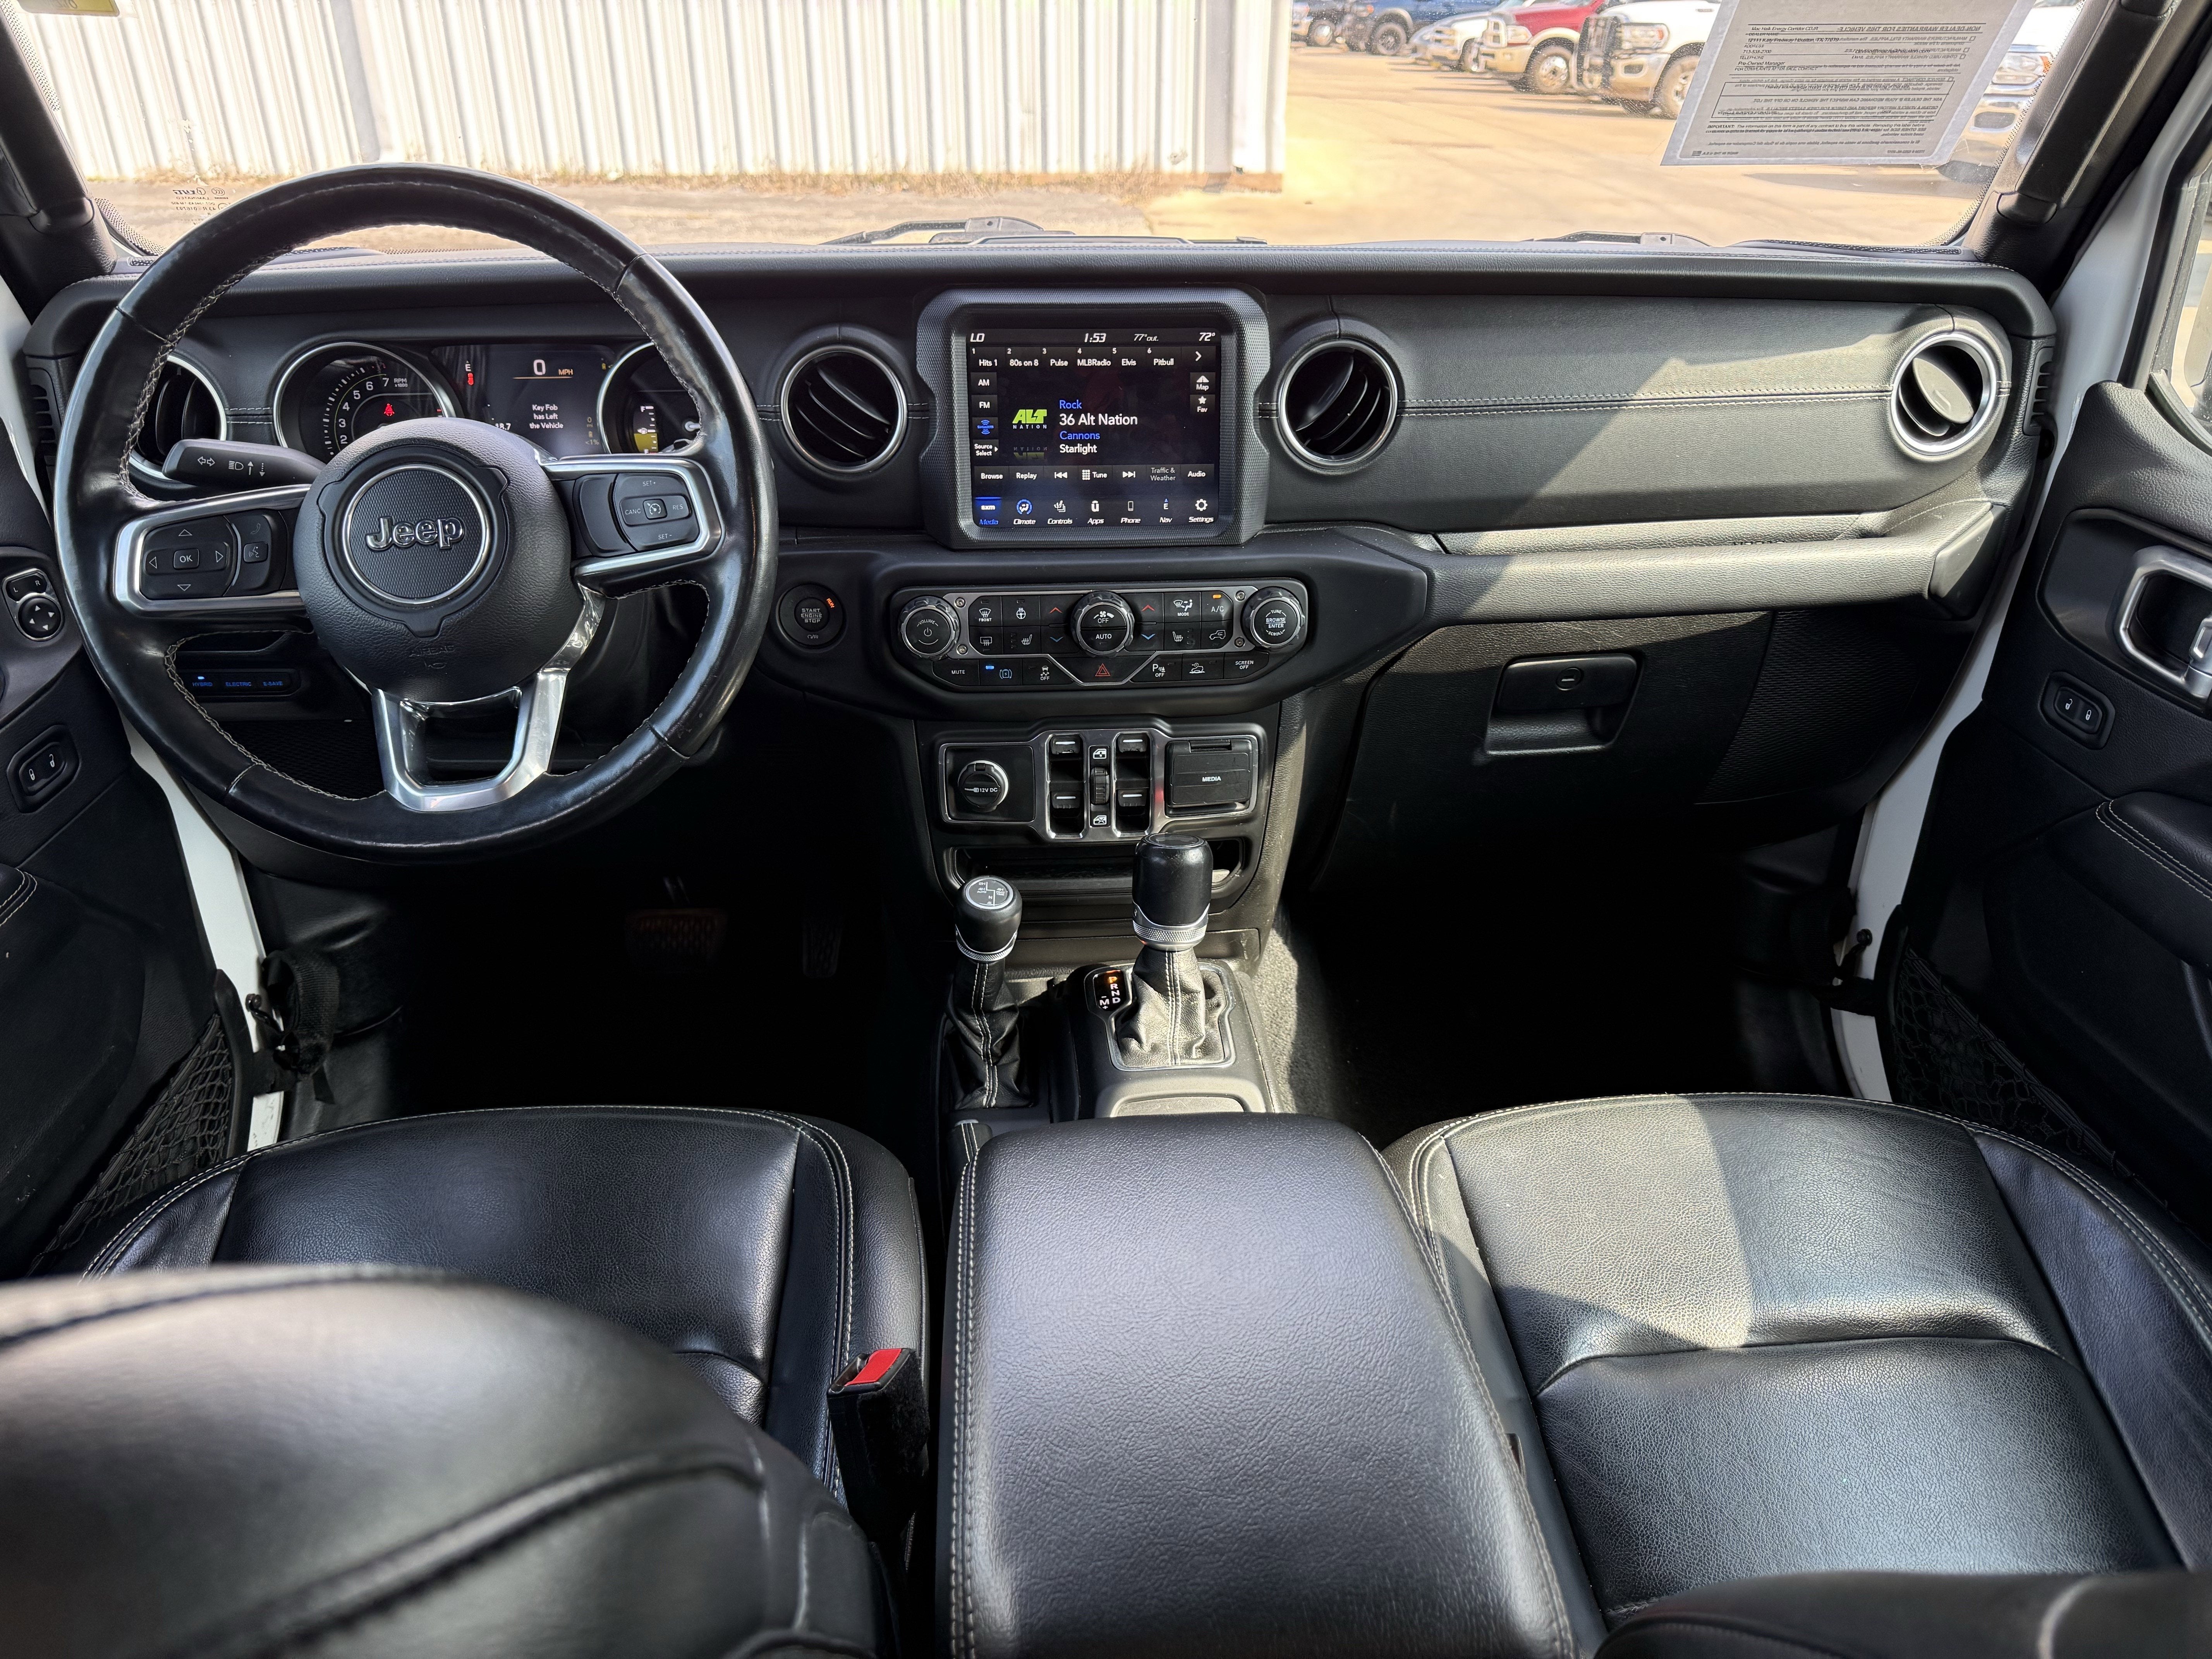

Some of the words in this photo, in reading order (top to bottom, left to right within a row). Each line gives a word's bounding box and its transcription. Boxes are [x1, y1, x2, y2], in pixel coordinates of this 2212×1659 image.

[970, 333, 985, 342] LO
[1084, 333, 1106, 343] 1:53
[465, 364, 471, 372] E
[533, 359, 546, 375] 0
[366, 381, 373, 391] 6
[383, 378, 389, 387] 7
[353, 390, 361, 400] 5
[342, 402, 350, 410] 4
[1059, 399, 1082, 410] Rock
[1012, 409, 1048, 424] ALT
[1059, 414, 1075, 426] 36
[1078, 413, 1096, 426] Alt
[1098, 413, 1138, 426] Nation
[339, 419, 346, 428] 3
[340, 435, 348, 444] 2
[1060, 431, 1101, 440] Cannons
[1060, 443, 1098, 455] Starlight
[365, 516, 464, 551] Jeep
[179, 554, 192, 563] OK
[826, 598, 835, 608] RUN
